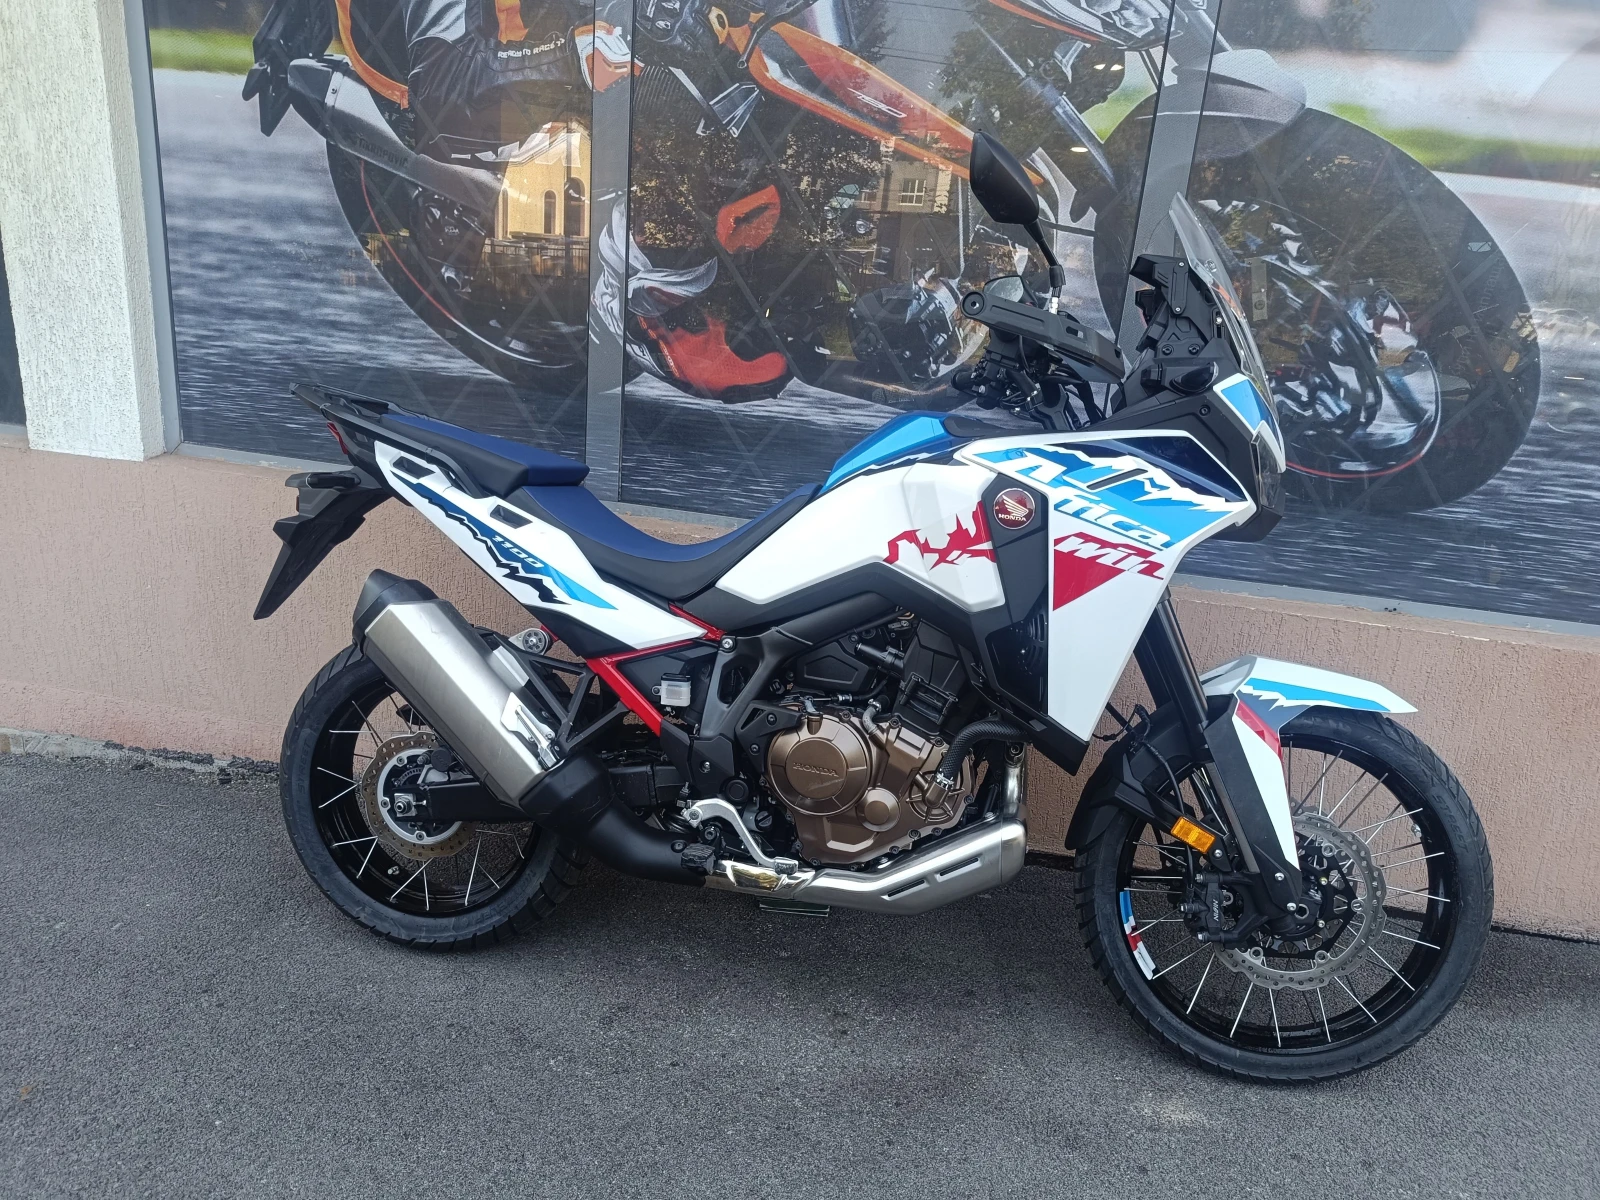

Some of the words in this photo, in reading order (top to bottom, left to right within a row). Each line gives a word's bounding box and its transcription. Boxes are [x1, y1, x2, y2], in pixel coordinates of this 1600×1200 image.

[498, 49, 522, 59] READY
[523, 48, 531, 56] TO
[533, 40, 555, 55] RACE
[998, 513, 1028, 522] HONDA
[492, 535, 545, 568] 1100
[792, 762, 839, 777] HONDA
[1432, 794, 1469, 853] STREET
